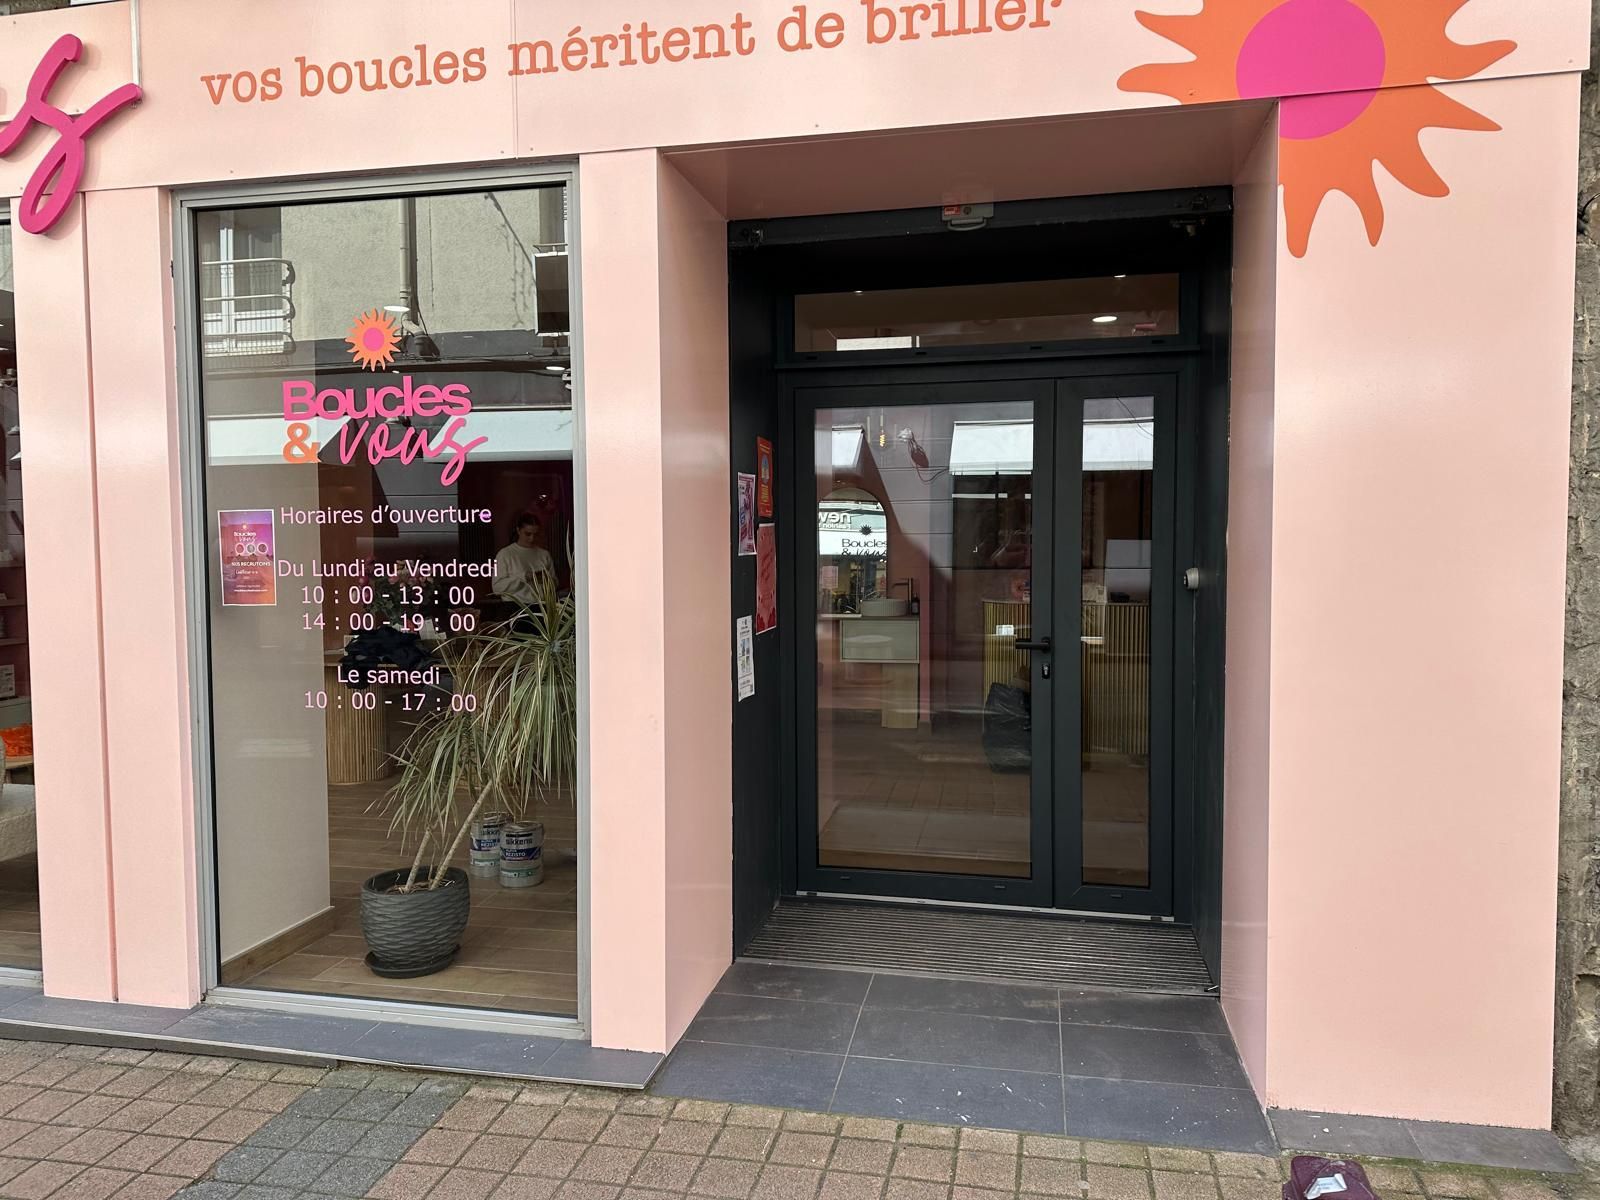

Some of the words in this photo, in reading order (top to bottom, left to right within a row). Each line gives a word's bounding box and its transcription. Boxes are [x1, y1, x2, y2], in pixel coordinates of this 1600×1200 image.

[200, 68, 283, 105] vos
[295, 44, 487, 98] boucles
[508, 13, 756, 76] méritent
[776, 5, 845, 51] de
[860, 0, 1062, 44] briller
[282, 375, 472, 421] Boucles
[282, 422, 321, 463] &
[281, 506, 364, 525] Horaires
[278, 559, 304, 577] Du
[312, 558, 365, 577] Lundi
[373, 563, 398, 577] au
[405, 558, 498, 578] Vendredi
[337, 665, 360, 684] Le
[367, 666, 440, 685] samedi
